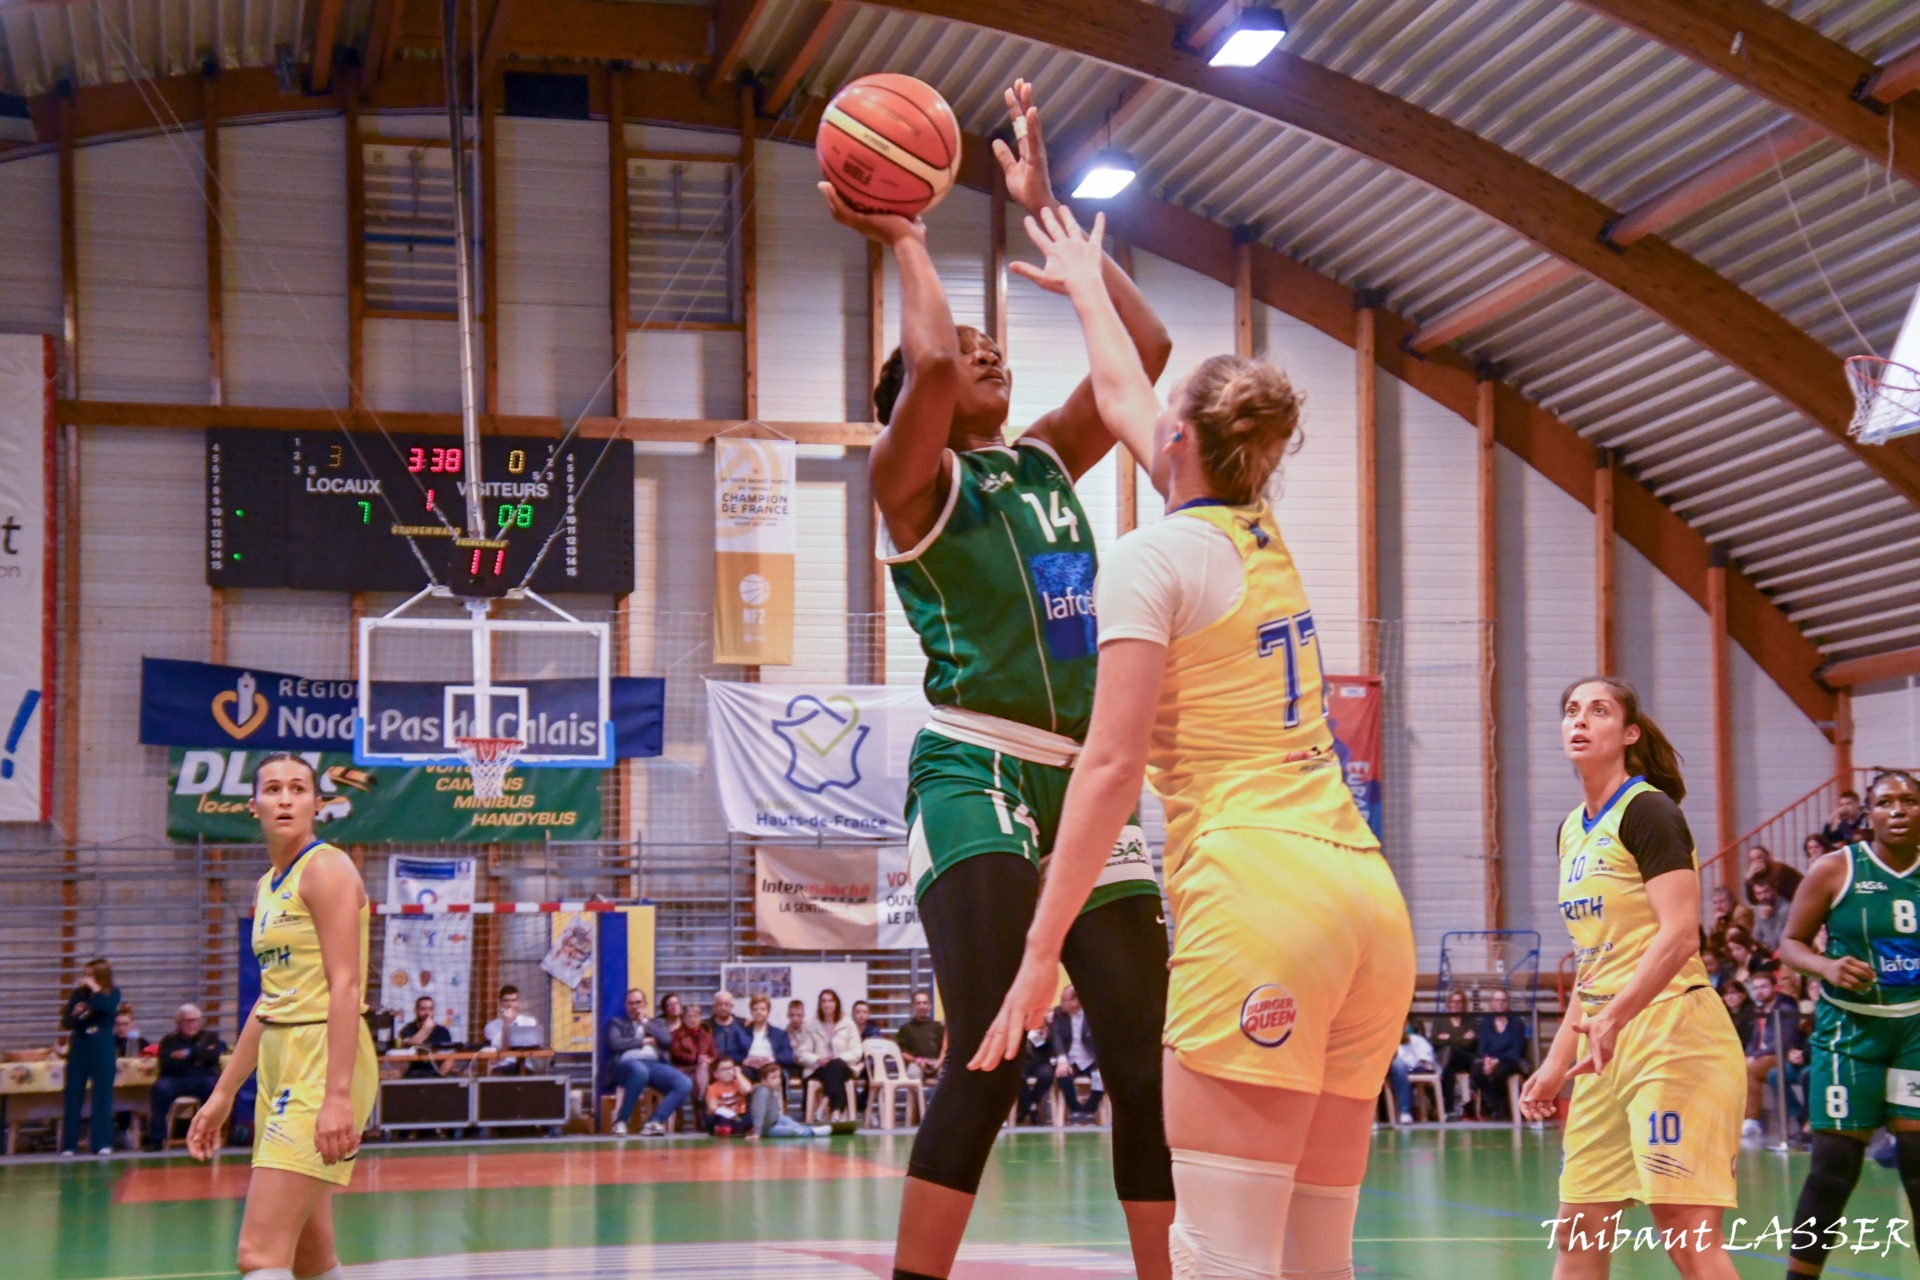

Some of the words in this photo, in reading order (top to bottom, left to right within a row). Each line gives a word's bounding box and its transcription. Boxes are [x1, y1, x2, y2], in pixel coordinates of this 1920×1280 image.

[329, 445, 342, 467] 3
[508, 450, 525, 473] 0
[306, 477, 381, 493] LOCAUX
[456, 481, 549, 498] VSITEURS
[721, 503, 737, 513] DE
[741, 504, 788, 515] FRANCE
[722, 492, 788, 504] CHAMPION
[357, 501, 372, 524] 7
[498, 504, 533, 528] 08
[1020, 491, 1080, 543] 14
[278, 676, 359, 698] RÉGIO
[435, 777, 524, 791] CAMNS
[453, 794, 536, 809] MINIBUS
[471, 811, 577, 826] HANDYBUS
[756, 813, 887, 829] Hauts-de-France
[1567, 855, 1586, 884] 10
[779, 902, 790, 913] LA
[888, 911, 900, 924] LE
[1893, 899, 1918, 933] 8
[1246, 997, 1294, 1016] BURGER
[1244, 1009, 1297, 1033] QUEEN
[275, 1088, 291, 1115] 4
[1826, 1085, 1848, 1118] 8
[1648, 1110, 1682, 1146] 10
